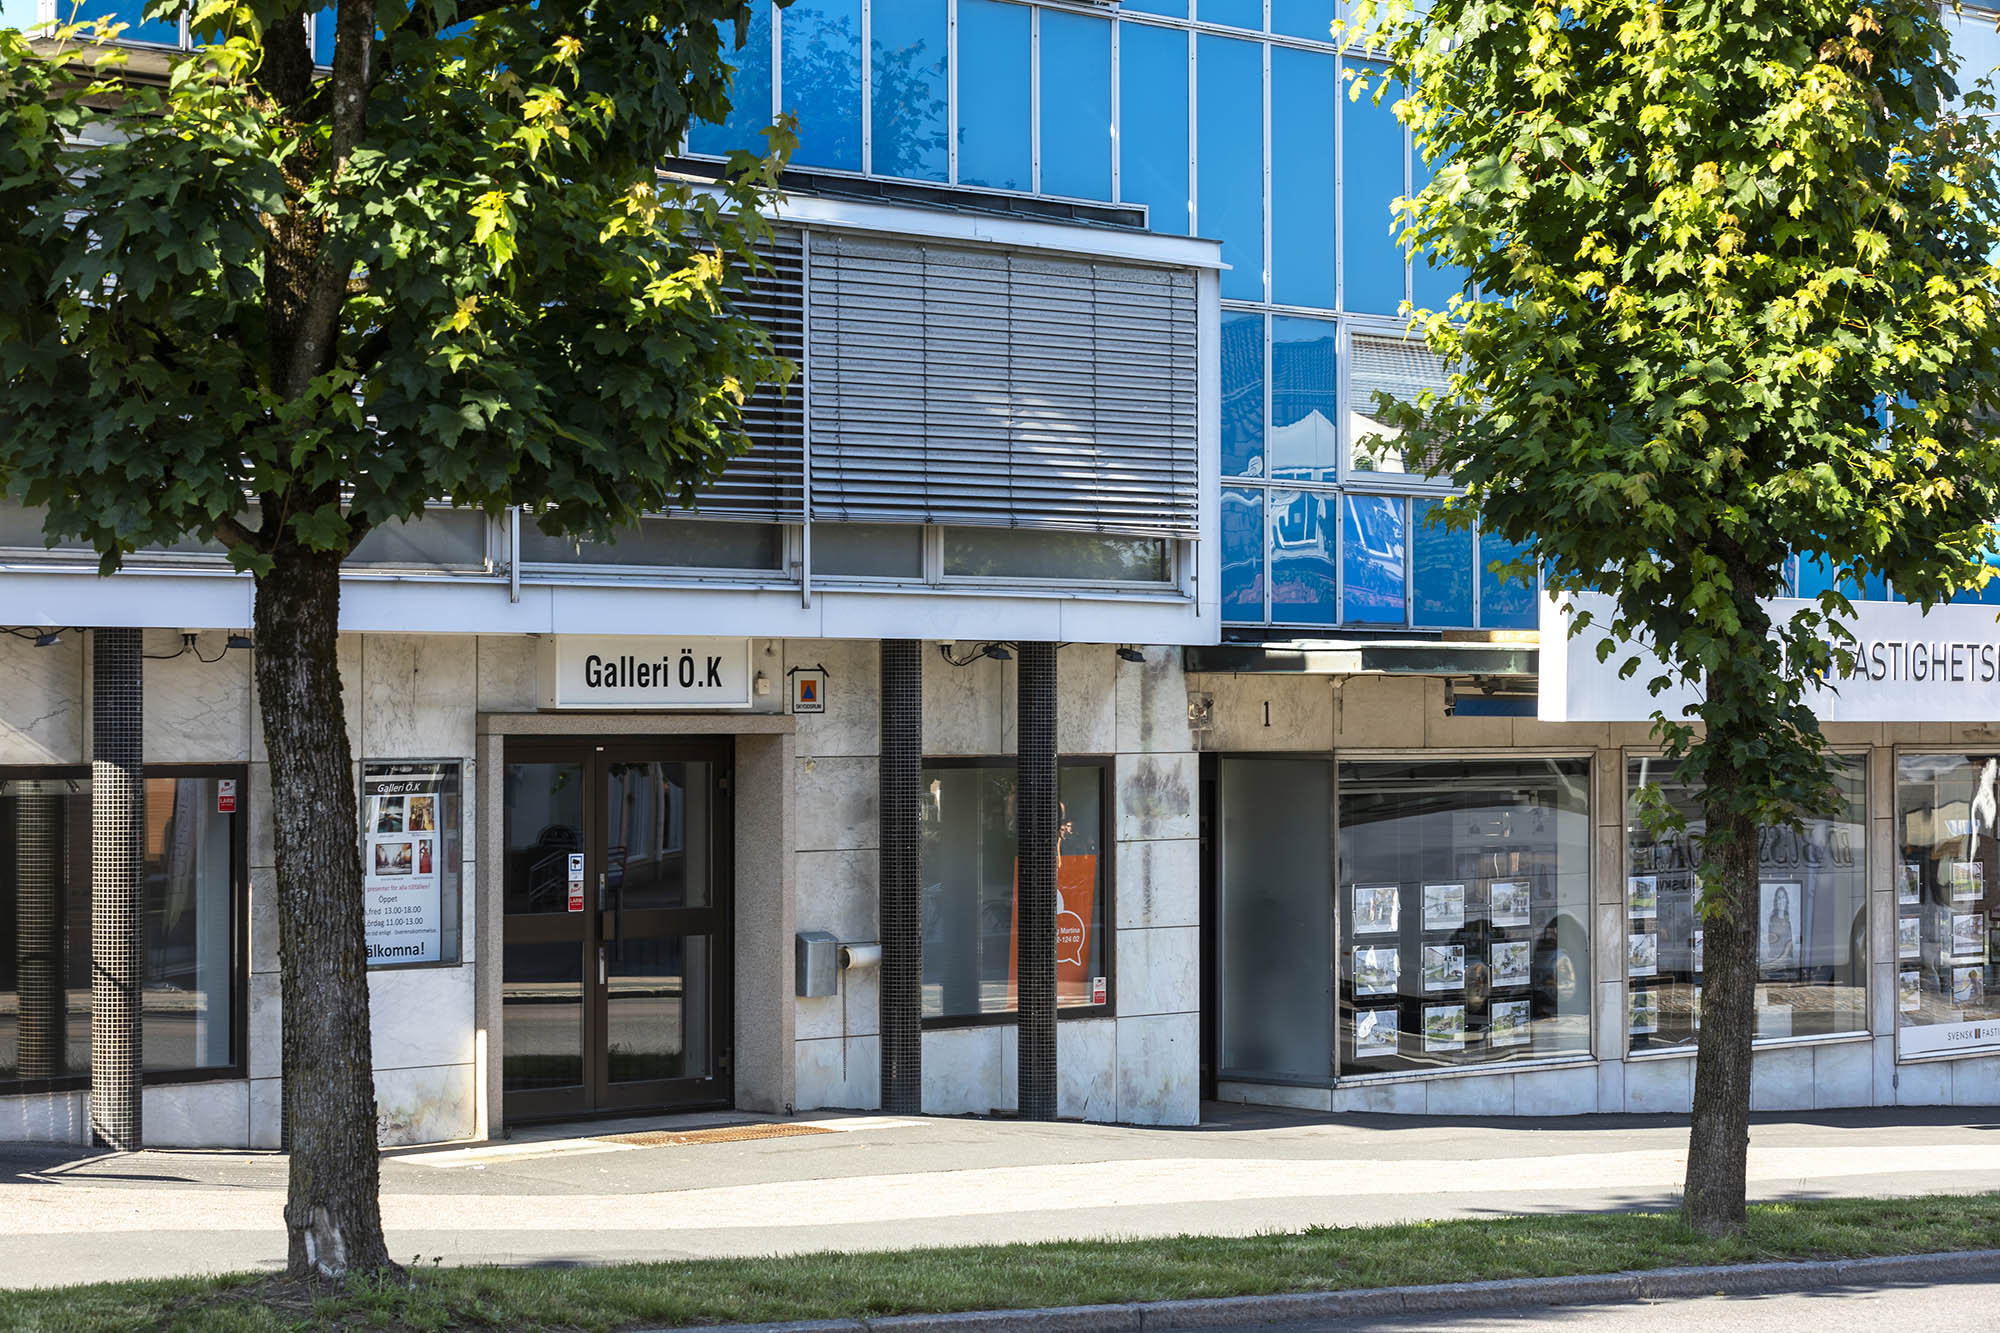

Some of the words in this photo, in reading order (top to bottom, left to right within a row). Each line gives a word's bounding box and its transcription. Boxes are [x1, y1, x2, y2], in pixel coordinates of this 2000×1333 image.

[585, 654, 669, 688] Galleri
[678, 648, 722, 688] Ö.K
[1838, 640, 2000, 682] FASTIGHETS
[1263, 701, 1271, 727] 1
[377, 783, 405, 793] Galleri
[405, 781, 421, 791] Ö.K
[385, 905, 422, 915] 13.00-18.00
[365, 919, 385, 928] ördag
[386, 917, 424, 926] 11.00-13.00
[366, 941, 425, 958] älkomna!
[1947, 1031, 1973, 1041] SVENSK
